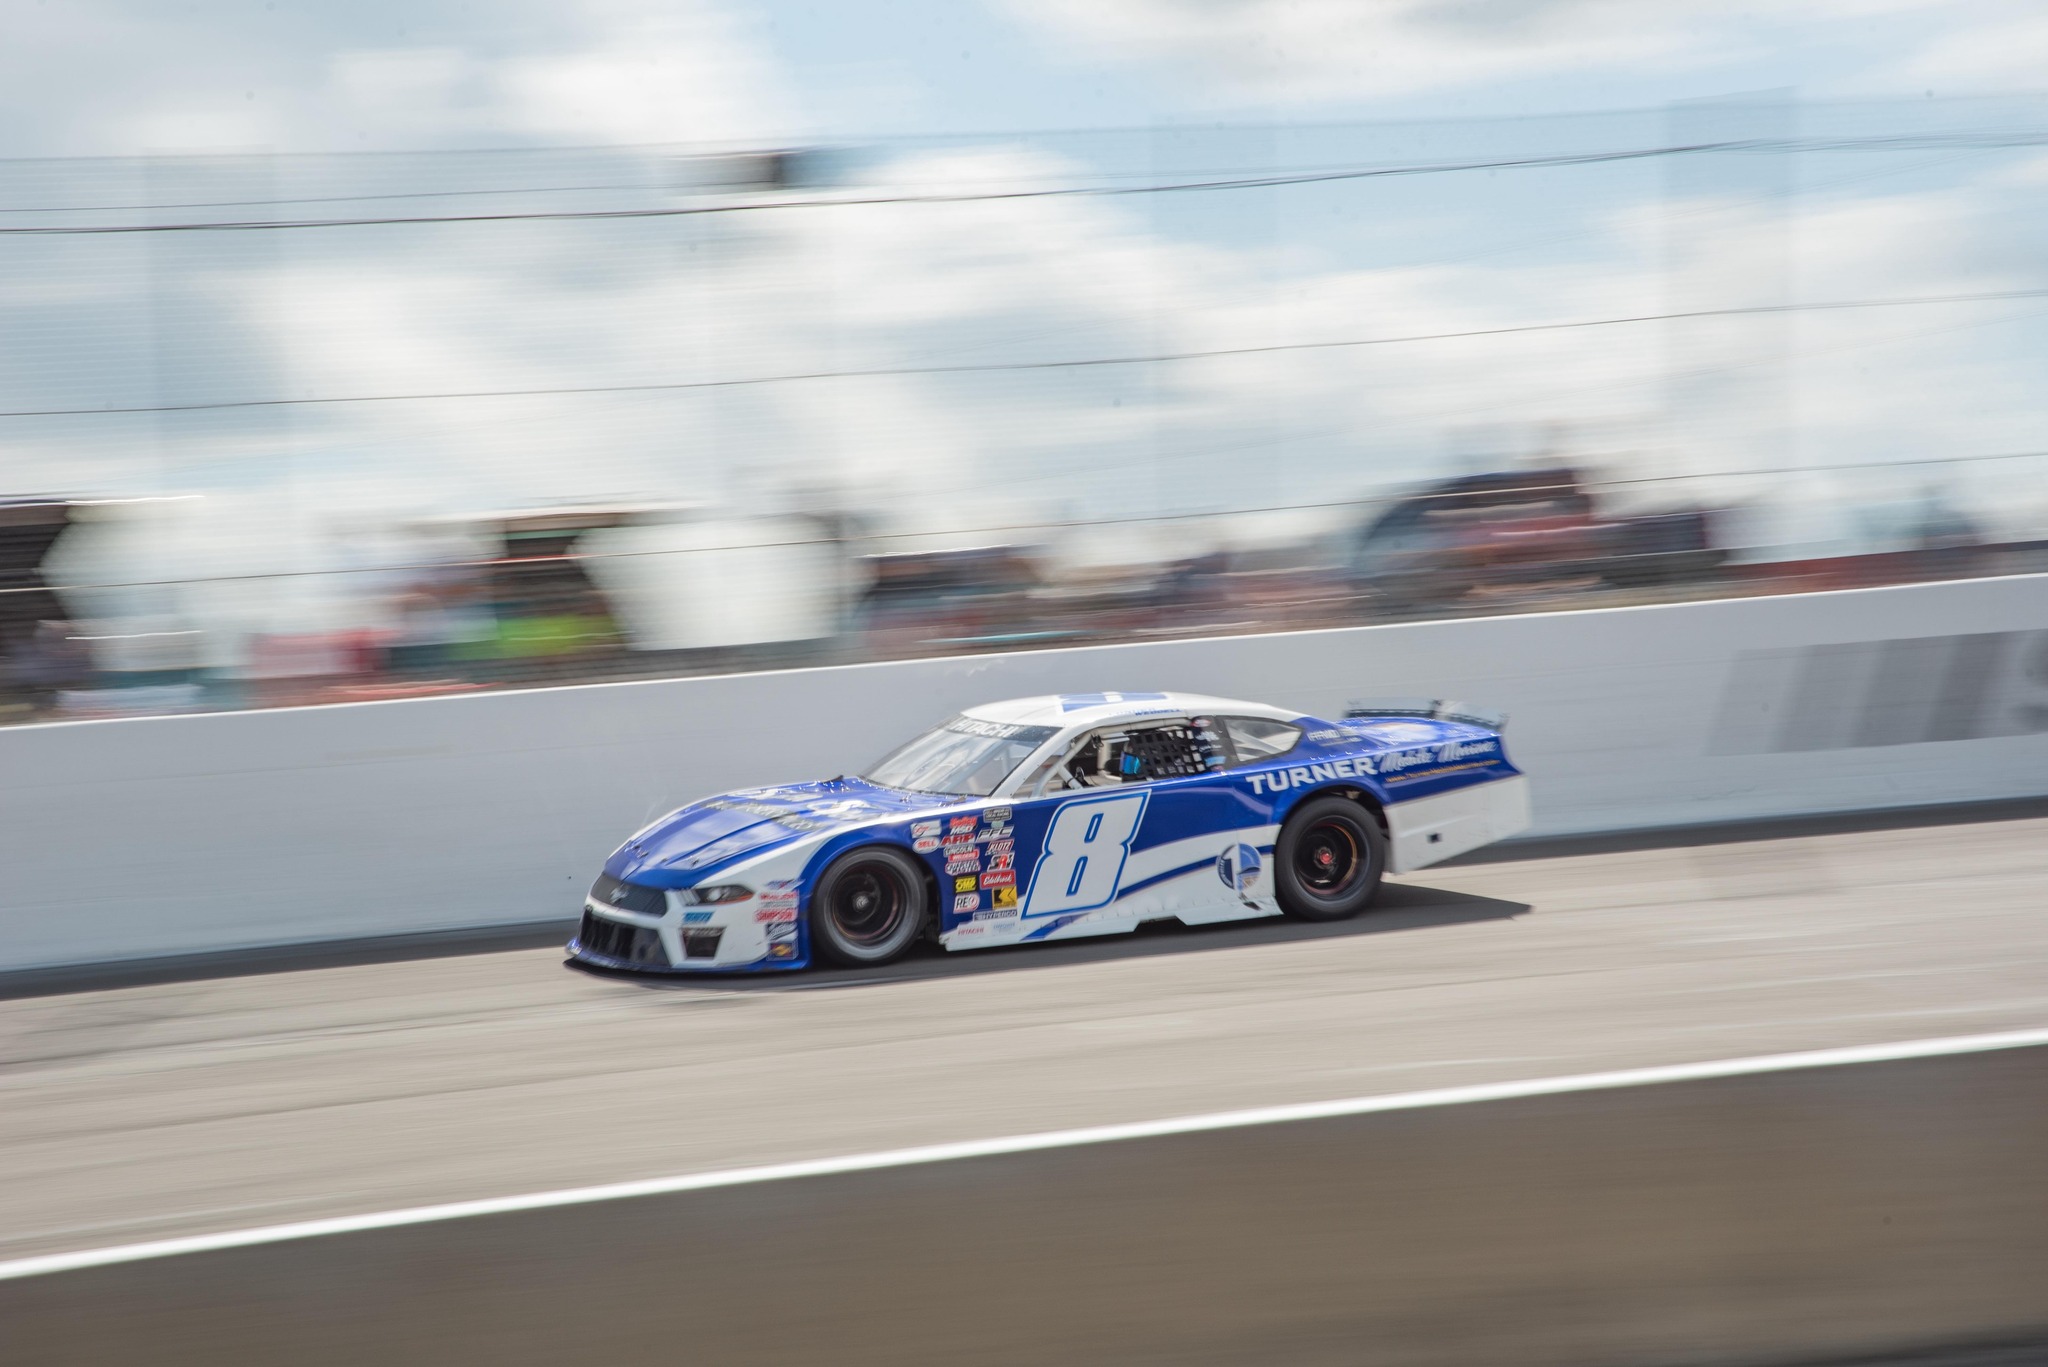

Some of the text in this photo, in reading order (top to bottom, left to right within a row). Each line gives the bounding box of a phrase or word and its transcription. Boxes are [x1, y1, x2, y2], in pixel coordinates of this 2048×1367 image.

[949, 720, 1019, 738] HITACHI
[1246, 757, 1378, 795] TURNER
[917, 839, 937, 848] BELL
[941, 834, 975, 846] ARP
[1021, 788, 1152, 920] 8
